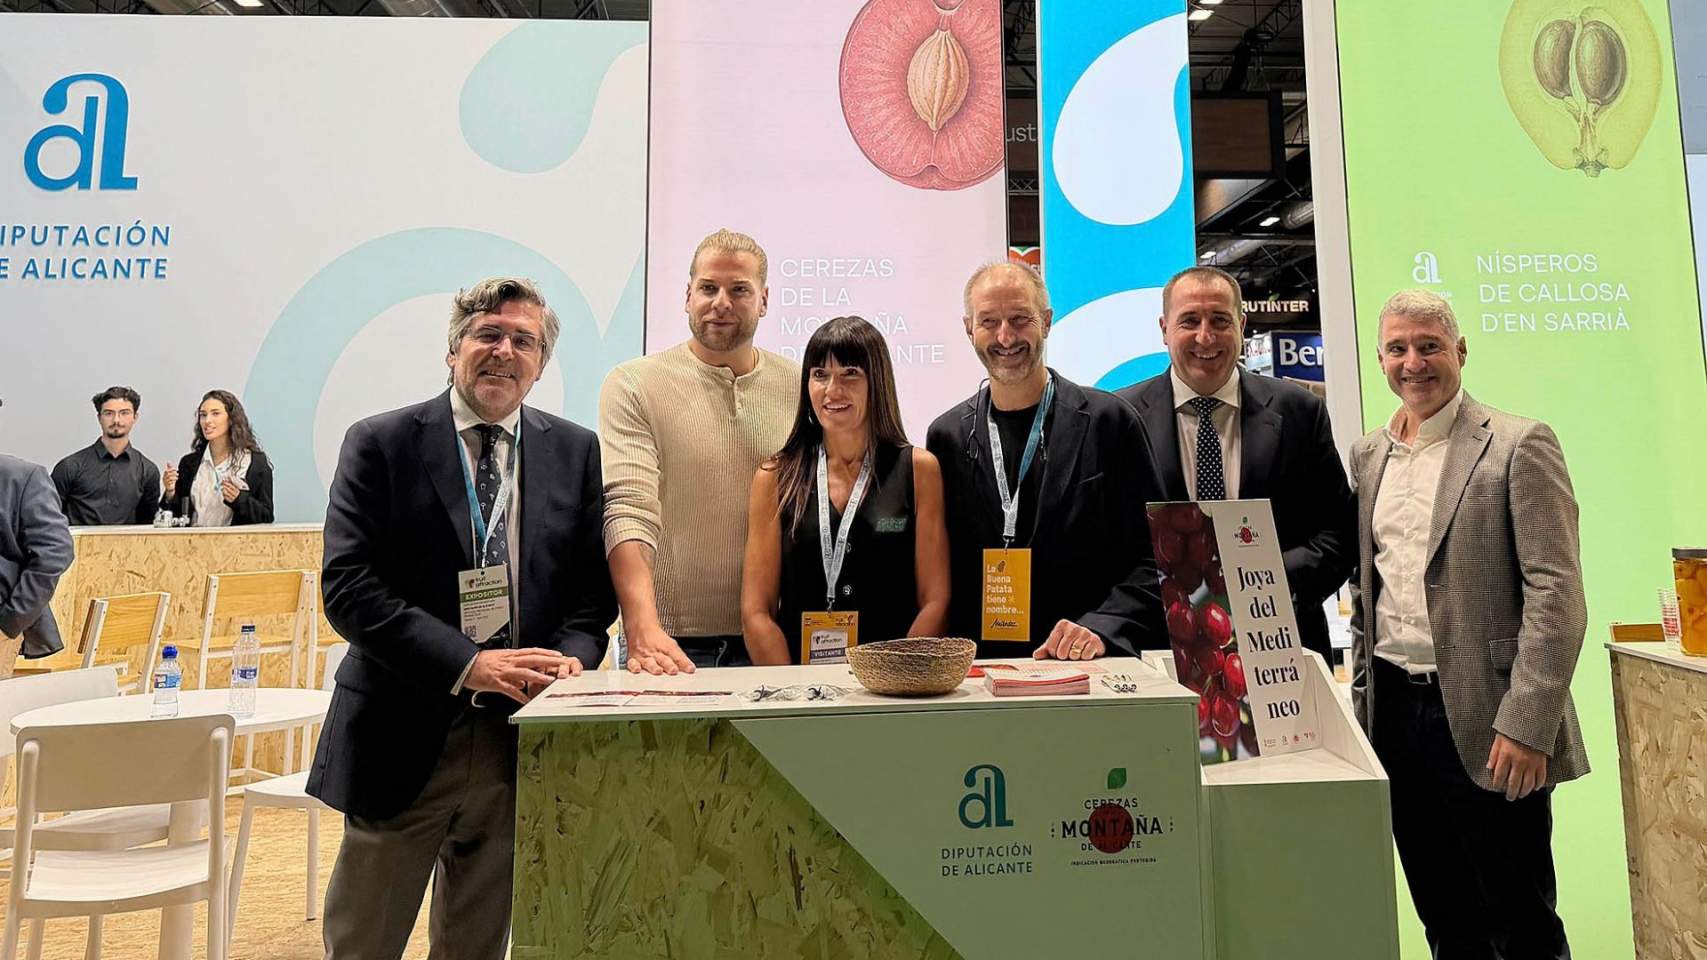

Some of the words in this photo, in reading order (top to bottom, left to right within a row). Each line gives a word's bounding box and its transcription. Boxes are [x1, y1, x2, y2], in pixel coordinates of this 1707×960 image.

[0, 220, 171, 247] IPUTACIÓN
[0, 258, 9, 280] E
[21, 258, 168, 280] ALICANTE
[780, 259, 894, 278] CEREZAS
[1476, 250, 1598, 273] NÍSPEROS
[781, 288, 813, 306] DE
[822, 288, 851, 306] LA
[1479, 284, 1511, 303] DE
[1519, 283, 1631, 303] CALLOSA
[1241, 300, 1309, 312] RUTINTER
[780, 312, 909, 335] MOÑA
[1481, 313, 1536, 332] D'EN
[986, 584, 1013, 593] Patata
[1237, 566, 1275, 592] Joya
[465, 589, 504, 600] EXPOSITOR
[1249, 595, 1277, 619] del
[1247, 626, 1293, 653] Medi
[815, 649, 842, 657] VISITANTE
[1254, 657, 1300, 686] terrá
[1267, 699, 1300, 720] neo
[1061, 814, 1163, 838] MONTAÑA
[941, 842, 1033, 859] DIPUTACIÓN
[942, 865, 960, 877] DE
[964, 861, 1033, 876] ALICANTE
